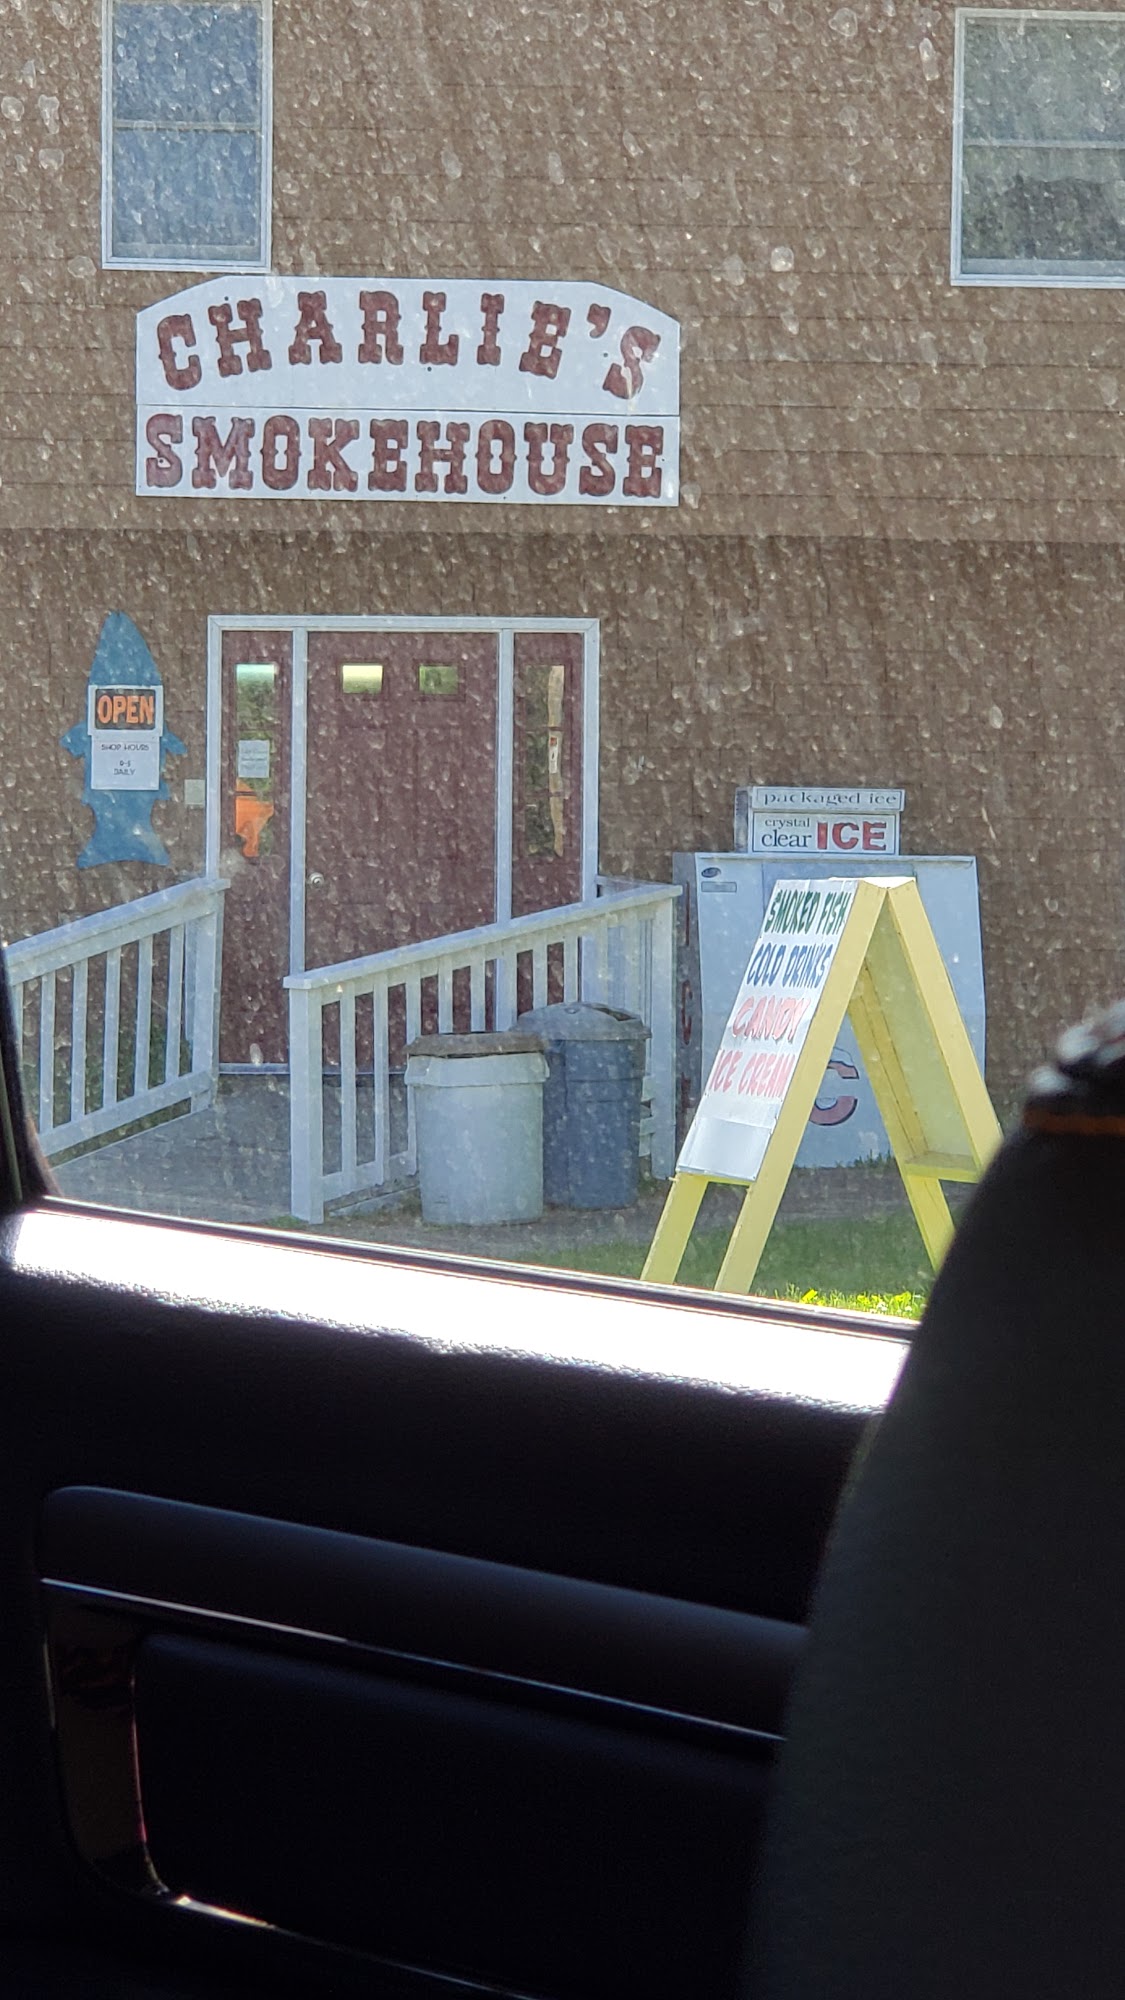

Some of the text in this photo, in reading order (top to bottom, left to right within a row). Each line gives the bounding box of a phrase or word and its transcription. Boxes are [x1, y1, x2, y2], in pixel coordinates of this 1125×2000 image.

[157, 291, 661, 400] CHARLIE'S
[146, 414, 664, 498] SMOKEHOUSE
[97, 695, 154, 725] OPEN
[764, 792, 897, 804] packaged ice
[761, 821, 887, 850] clear ICE
[764, 817, 811, 829] crystal
[764, 889, 853, 935] SMOKED FISH
[746, 942, 834, 989] COLD DRINKS
[732, 995, 810, 1042] CANDY
[708, 1050, 796, 1098] ICE CREAM
